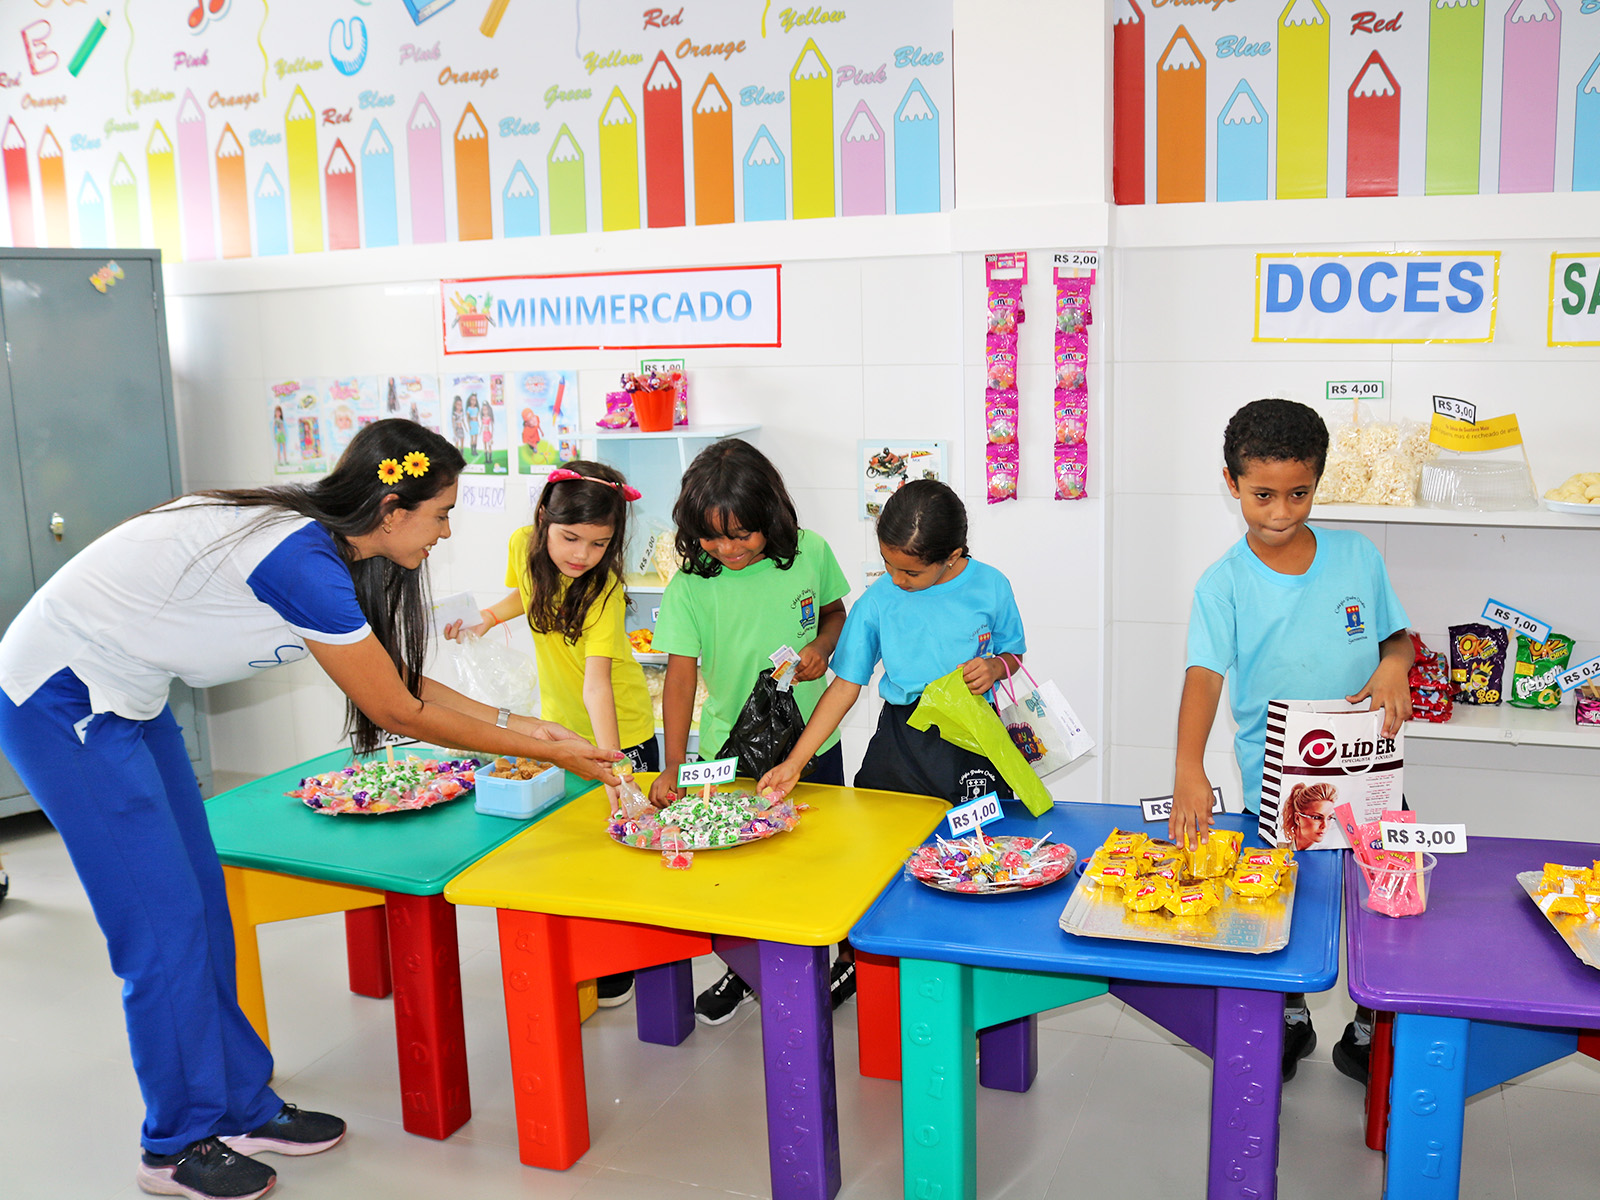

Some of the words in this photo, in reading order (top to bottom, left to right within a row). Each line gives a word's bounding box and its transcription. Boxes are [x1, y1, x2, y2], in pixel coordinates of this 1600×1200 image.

[643, 7, 684, 30] Red
[779, 6, 846, 33] Yellow
[1350, 11, 1402, 35] Red
[329, 16, 368, 76] U
[399, 41, 441, 65] Pink
[676, 38, 746, 61] Orange
[894, 45, 944, 68] Blue
[1216, 35, 1271, 59] Blue
[174, 50, 209, 70] Pink
[274, 58, 324, 79] Yellow
[583, 50, 643, 75] Yellow
[438, 66, 499, 87] Orange
[836, 63, 887, 87] Pink
[21, 93, 67, 110] Orange
[208, 91, 260, 109] Orange
[358, 90, 395, 109] Blue
[544, 84, 592, 110] Green
[739, 85, 785, 106] Blue
[322, 107, 353, 126] Red
[499, 116, 540, 137] Blue
[104, 119, 139, 139] Green
[249, 129, 282, 147] Blue
[1054, 254, 1069, 264] R$
[1073, 255, 1097, 265] 2,00
[1265, 261, 1484, 313] DOCES
[497, 290, 752, 328] MINIMERCADO
[1331, 384, 1347, 395] R$
[1351, 384, 1379, 395] 4,00
[1438, 400, 1452, 412] R$
[1455, 403, 1473, 419] 3,00
[1494, 608, 1510, 621] R$
[1513, 616, 1537, 633] 1,00
[1459, 634, 1489, 656] OK
[1564, 672, 1580, 684] R$
[1341, 737, 1396, 758] LÍDER
[682, 771, 699, 782] R$
[703, 765, 731, 780] 0,10
[952, 813, 970, 829] R$
[971, 802, 997, 822] 1,00
[1387, 828, 1409, 845] R$
[1415, 830, 1455, 847] 3,00
[1409, 1089, 1437, 1116] e
